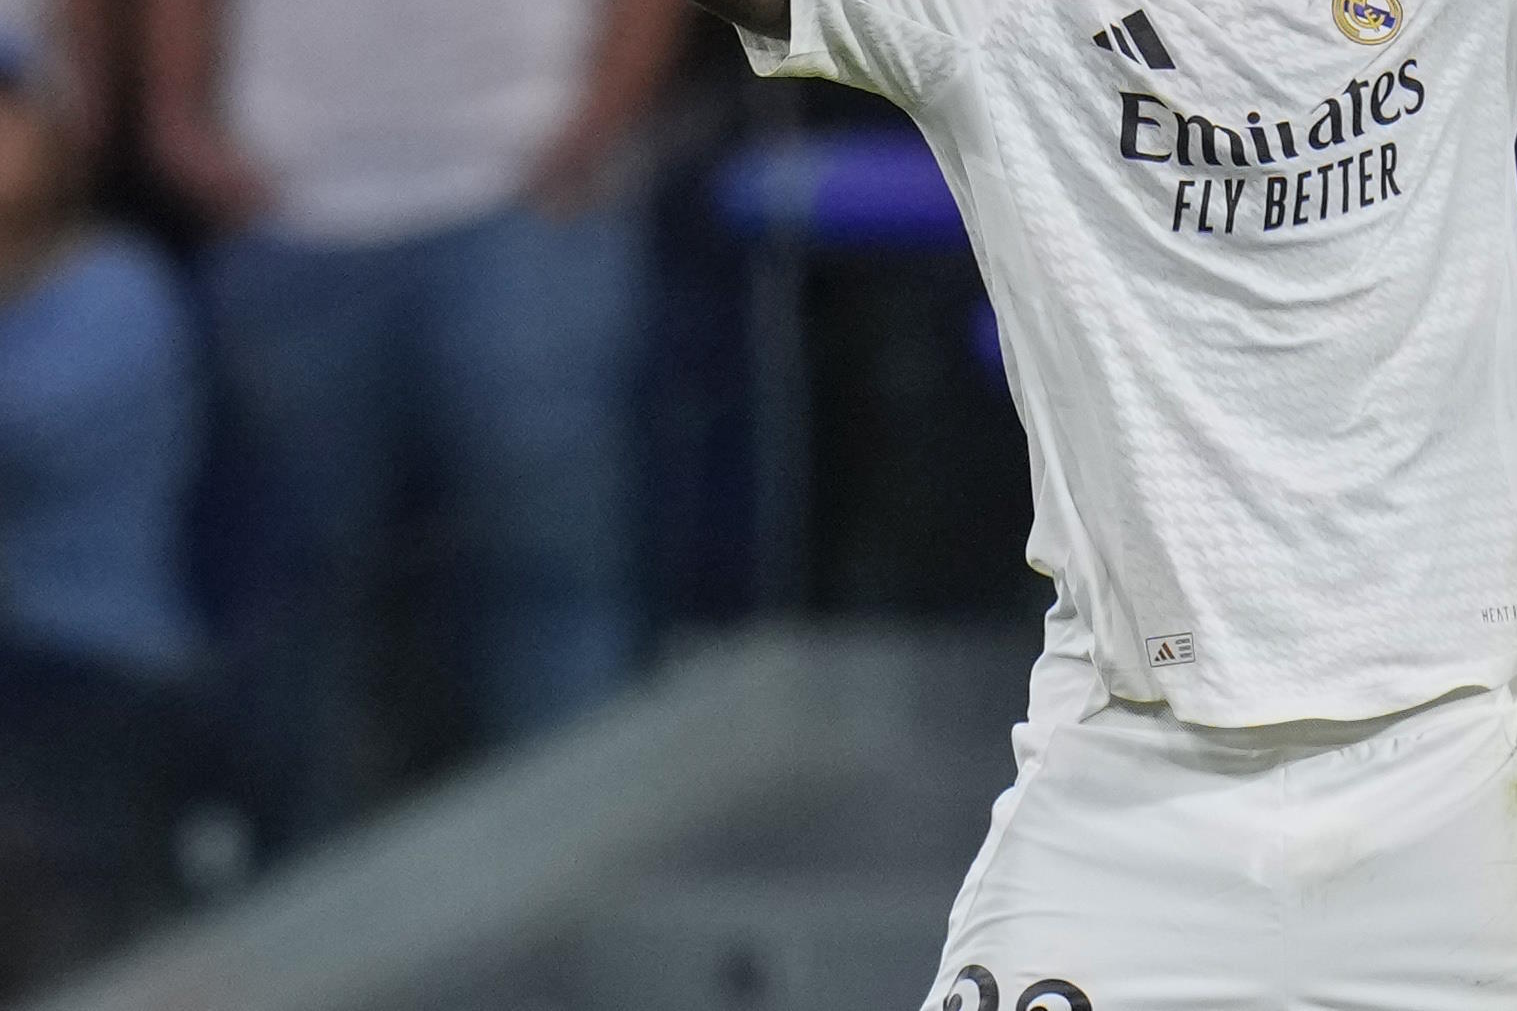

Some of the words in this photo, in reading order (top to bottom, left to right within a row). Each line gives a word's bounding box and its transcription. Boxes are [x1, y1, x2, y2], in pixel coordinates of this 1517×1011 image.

[1119, 58, 1425, 168] Emirates
[1172, 178, 1247, 234] FLY
[1263, 142, 1402, 232] BETTER
[1480, 605, 1509, 624] HEAT
